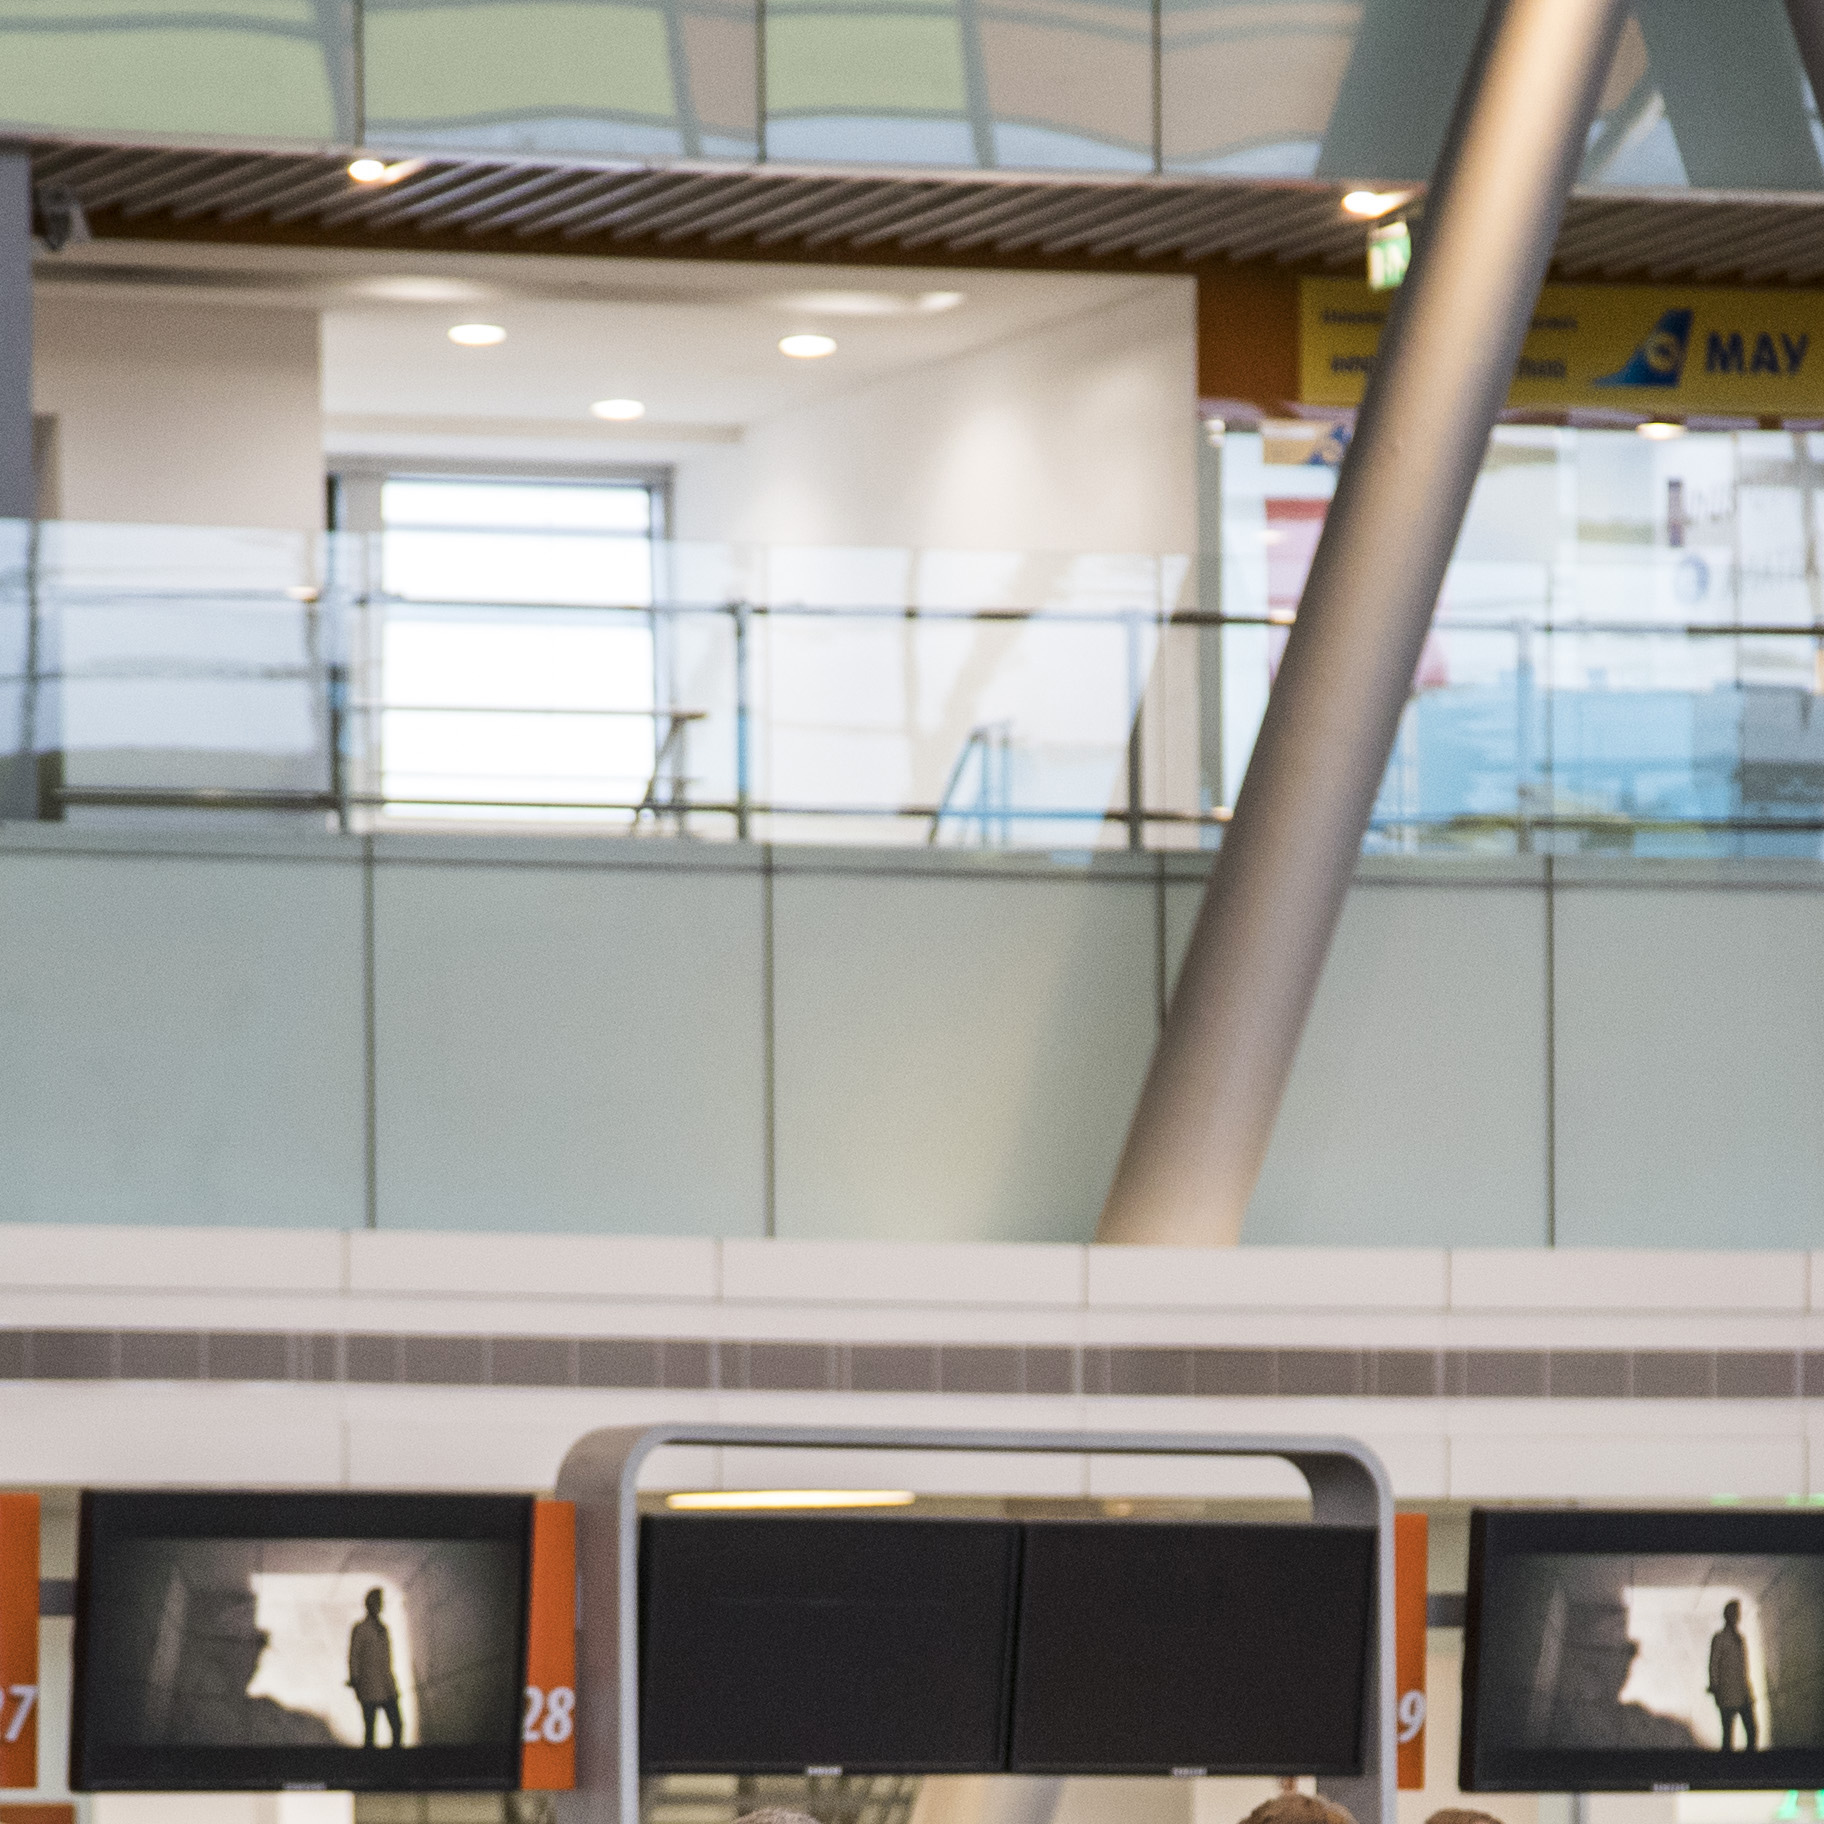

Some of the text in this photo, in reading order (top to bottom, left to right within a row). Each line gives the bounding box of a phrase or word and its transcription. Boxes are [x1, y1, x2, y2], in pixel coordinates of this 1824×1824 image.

[1704, 331, 1812, 377] MAY
[523, 1685, 576, 1745] 28
[1398, 1690, 1425, 1744] 9
